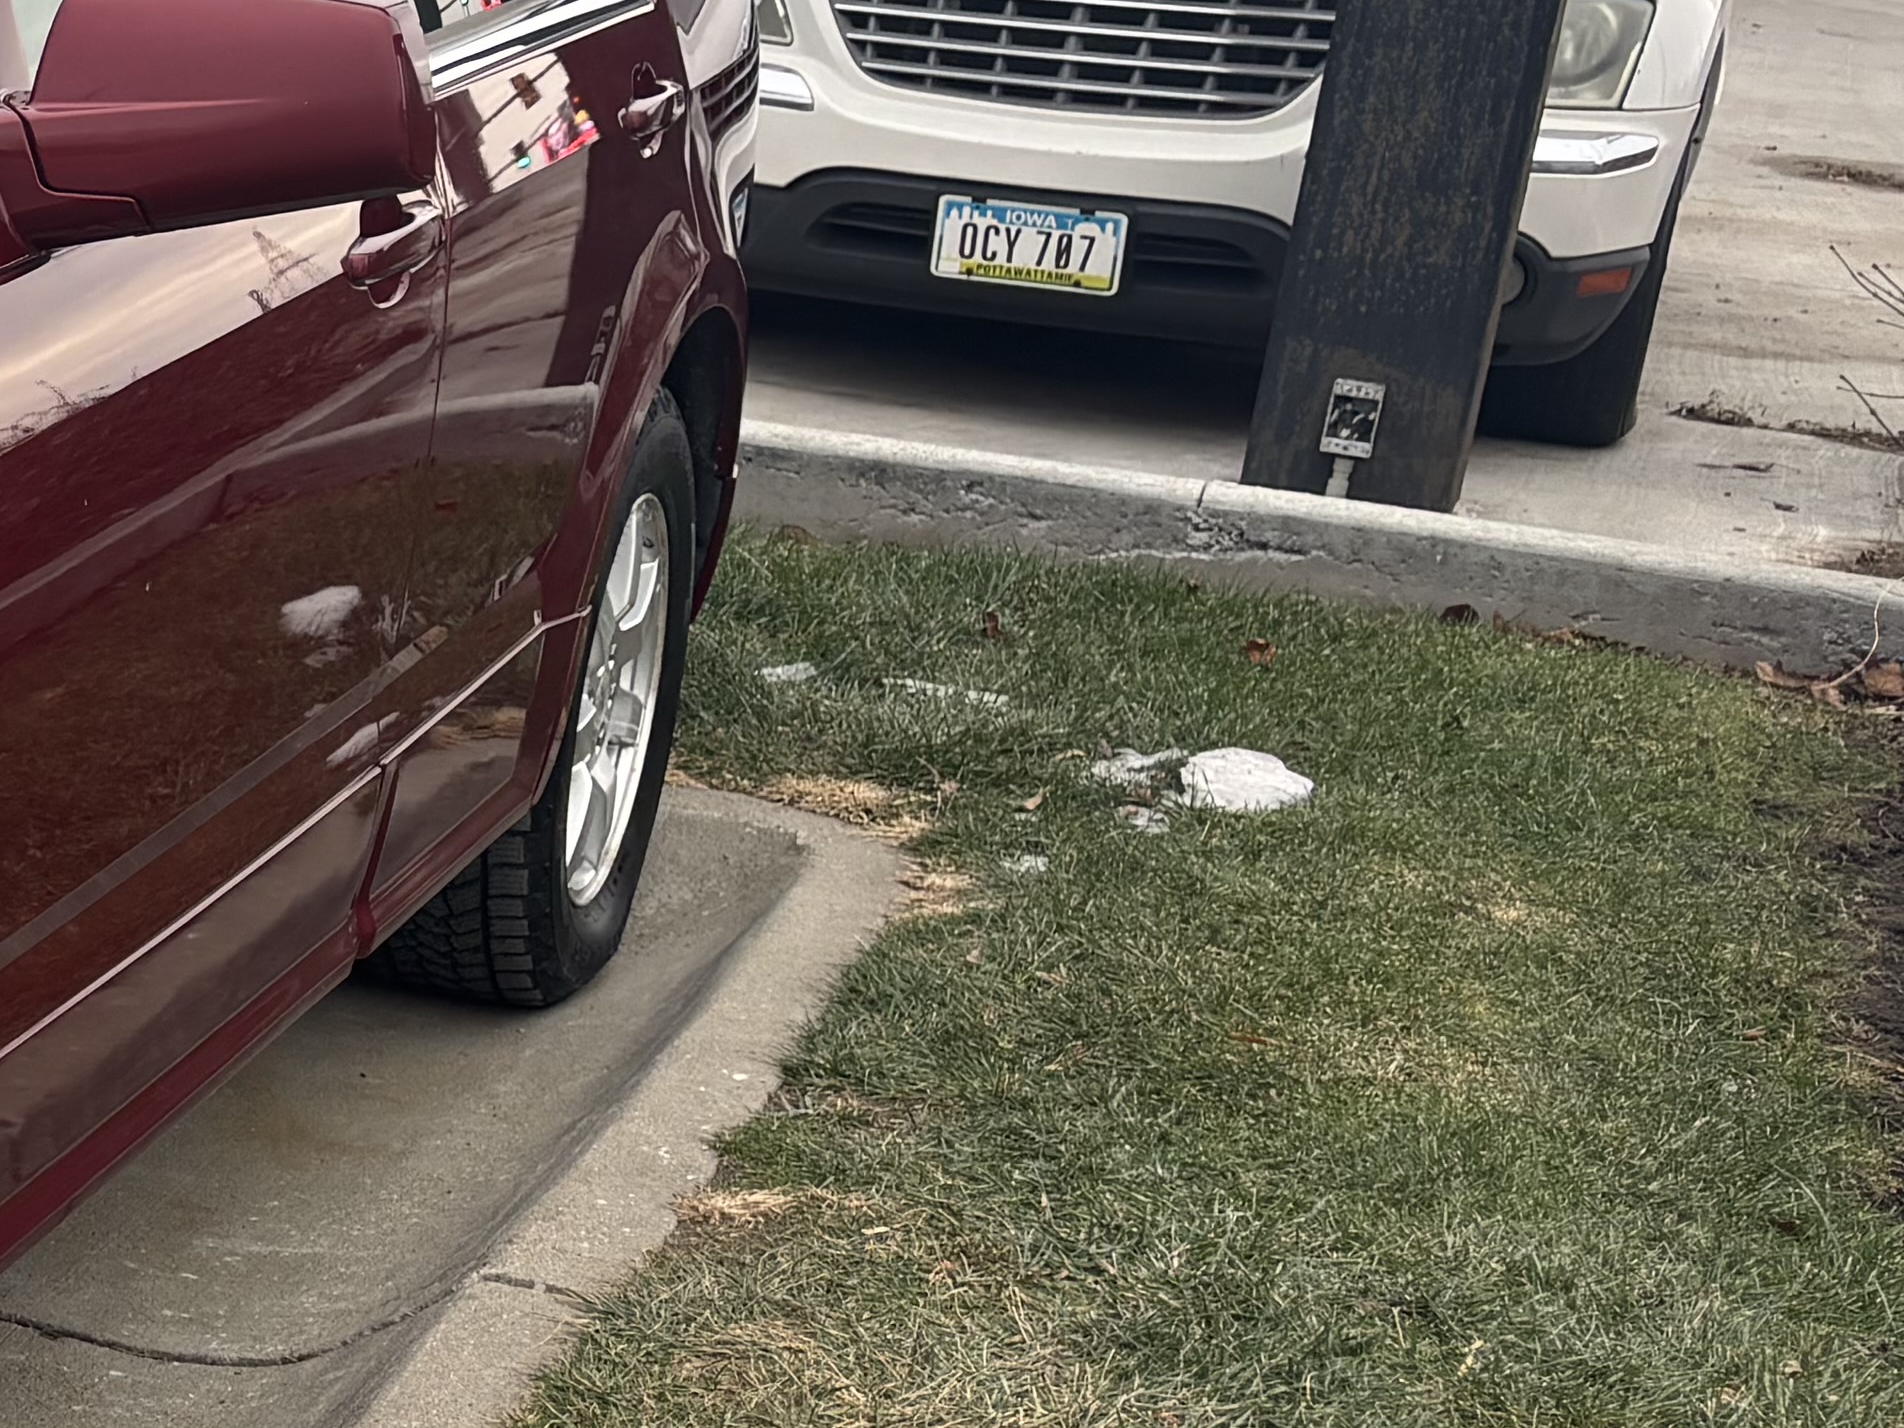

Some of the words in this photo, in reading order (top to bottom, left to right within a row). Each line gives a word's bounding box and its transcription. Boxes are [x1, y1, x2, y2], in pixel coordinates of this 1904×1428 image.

[1005, 209, 1057, 229] IOWA
[1035, 230, 1096, 272] 707
[976, 264, 1074, 283] POTTAWATTAMIE
